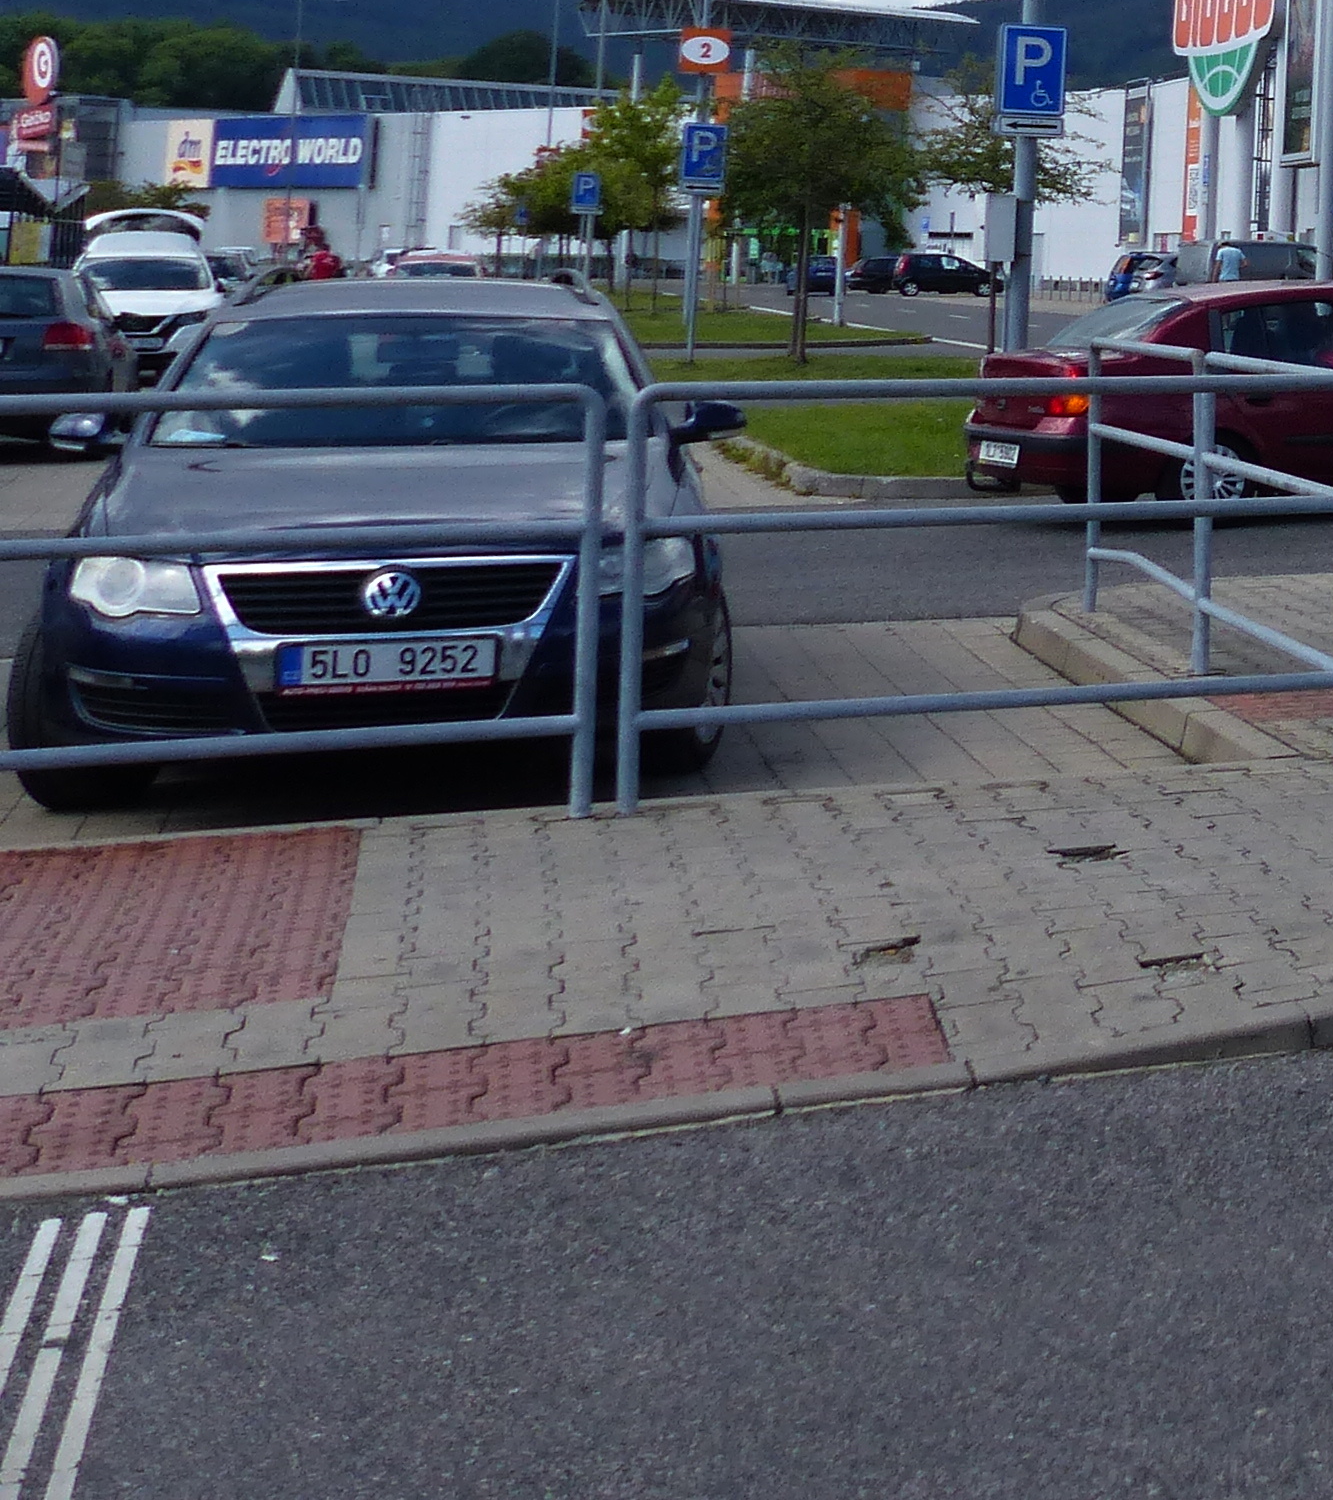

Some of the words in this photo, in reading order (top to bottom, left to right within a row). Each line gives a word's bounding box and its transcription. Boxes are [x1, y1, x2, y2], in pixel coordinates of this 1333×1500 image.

[701, 42, 712, 59] 2
[1014, 35, 1053, 86] P
[214, 138, 292, 166] ELECTRO
[298, 136, 363, 165] WORLD
[691, 131, 717, 162] P
[581, 175, 595, 195] P
[398, 643, 480, 676] 9252
